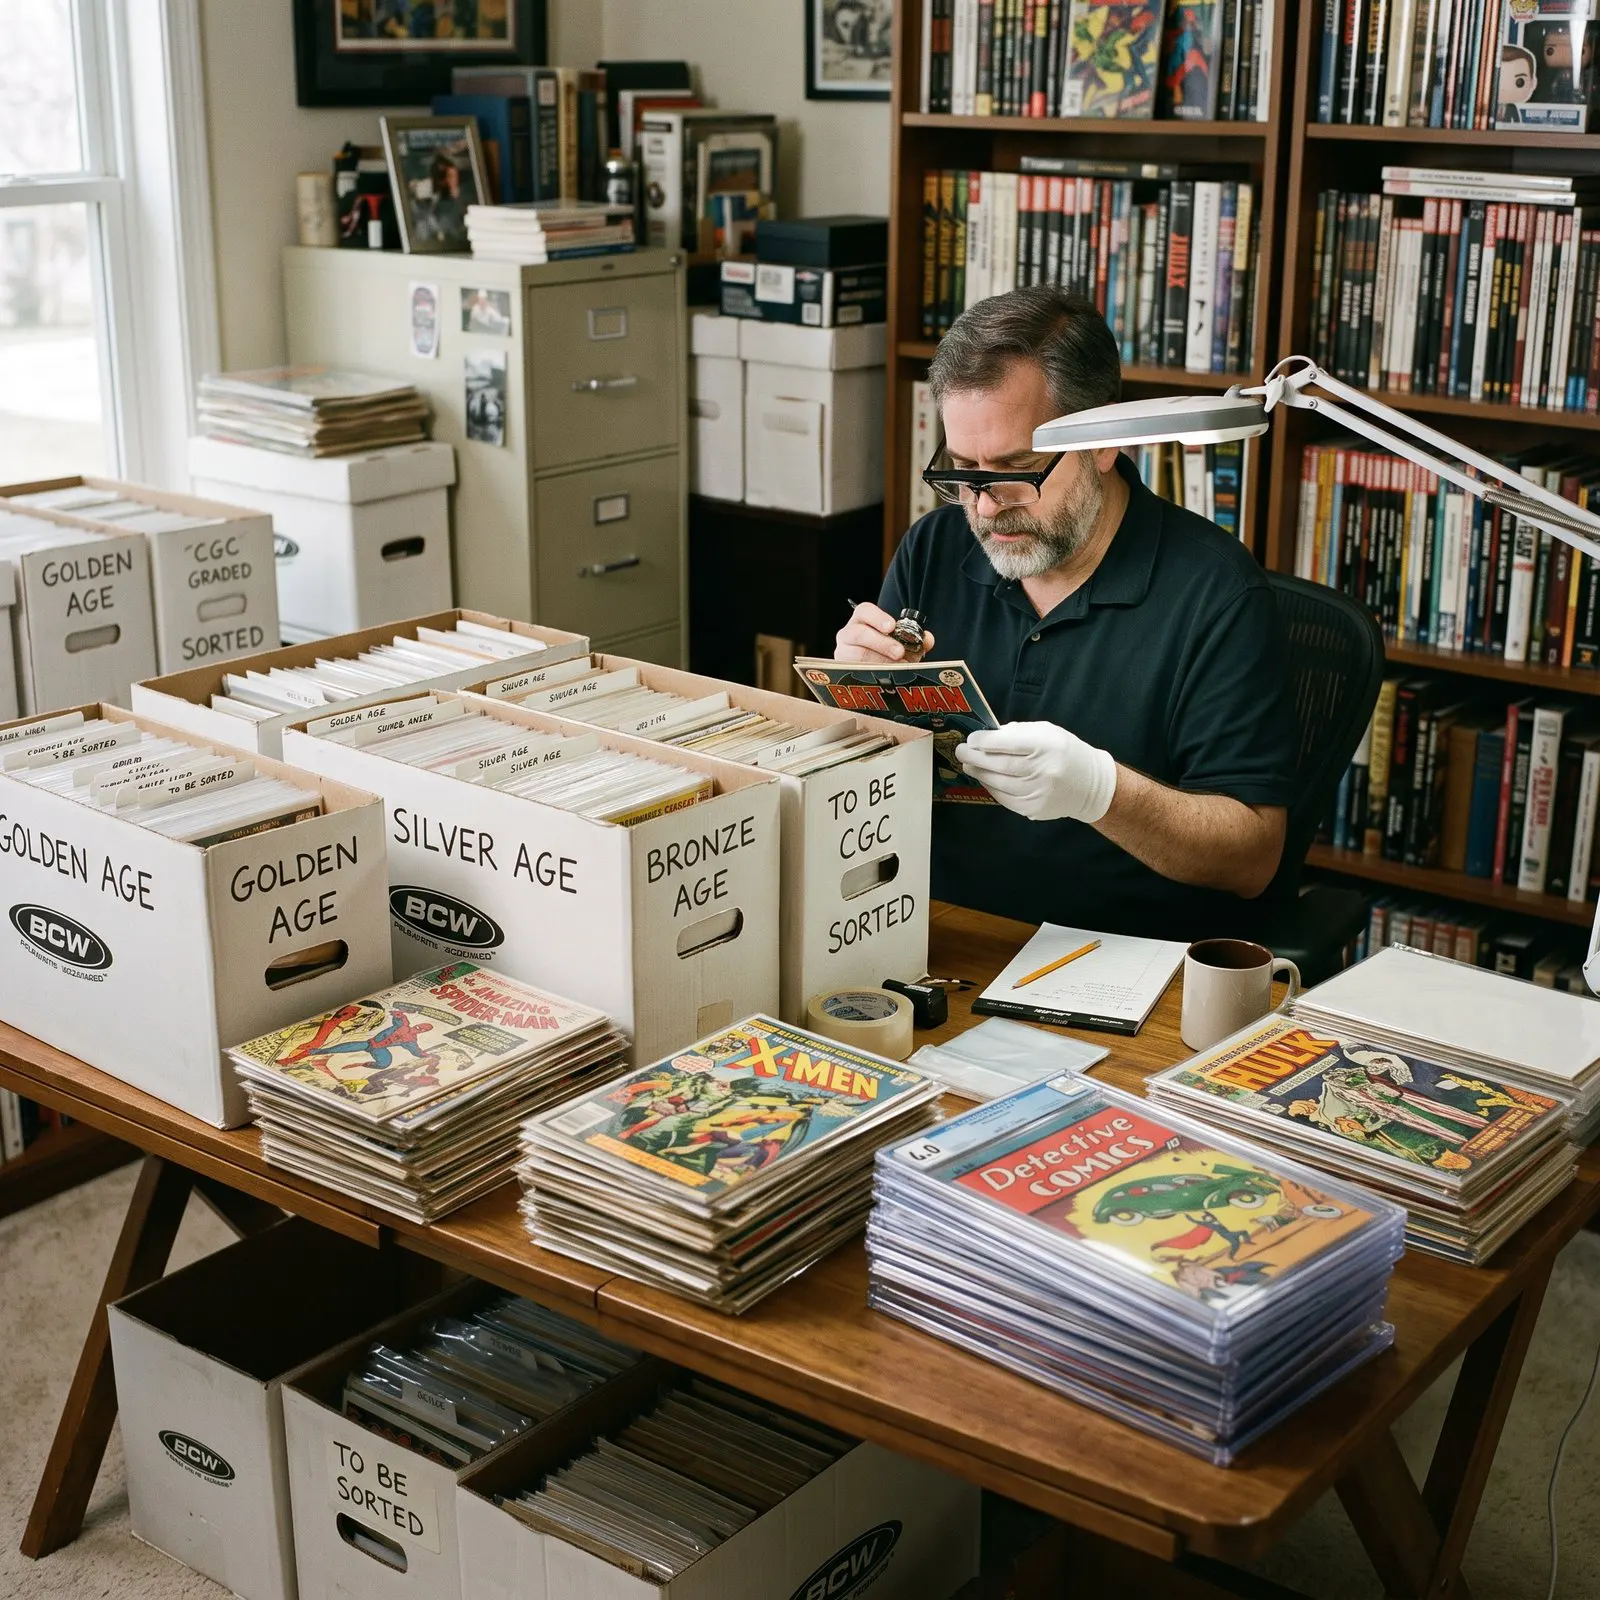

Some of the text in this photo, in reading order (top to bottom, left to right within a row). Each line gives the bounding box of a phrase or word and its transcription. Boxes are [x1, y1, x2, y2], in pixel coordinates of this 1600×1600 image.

[42, 550, 133, 586] GOLDEN
[195, 537, 240, 562] CGC
[188, 562, 252, 589] GRADED
[66, 585, 115, 617] AGE
[182, 625, 264, 661] SORTED
[582, 681, 597, 695] AGE
[367, 707, 386, 719] AGE
[62, 748, 75, 760] BE
[82, 739, 117, 755] SORTED
[478, 745, 528, 769] SILVER AGE
[510, 749, 561, 774] SILVER AGE
[168, 786, 181, 796] TO
[185, 780, 197, 793] BE
[200, 769, 234, 788] SORTED
[828, 773, 897, 820] TO BE
[394, 807, 578, 894] SILVER AGE
[647, 816, 756, 884] BRONZE
[840, 814, 892, 860] CGC
[0, 813, 155, 911] GOLDEN AGE
[231, 836, 358, 902] GOLDEN
[673, 868, 729, 917] AGE
[29, 915, 91, 958] BCW
[269, 891, 338, 943] AGE
[404, 894, 479, 938] BCW
[828, 894, 915, 954] SORTED
[430, 983, 560, 1030] SPIDER-MAN
[469, 986, 552, 1016] AMAZING
[727, 1036, 879, 1101] X-MEN
[1211, 1029, 1339, 1091] HULK
[979, 1115, 1134, 1192] Detective
[1029, 1134, 1154, 1197] COMICS
[174, 1438, 218, 1471] BCW
[333, 1441, 409, 1497] TO BE
[337, 1476, 424, 1537] SORTED
[806, 1537, 879, 1600] BCW
